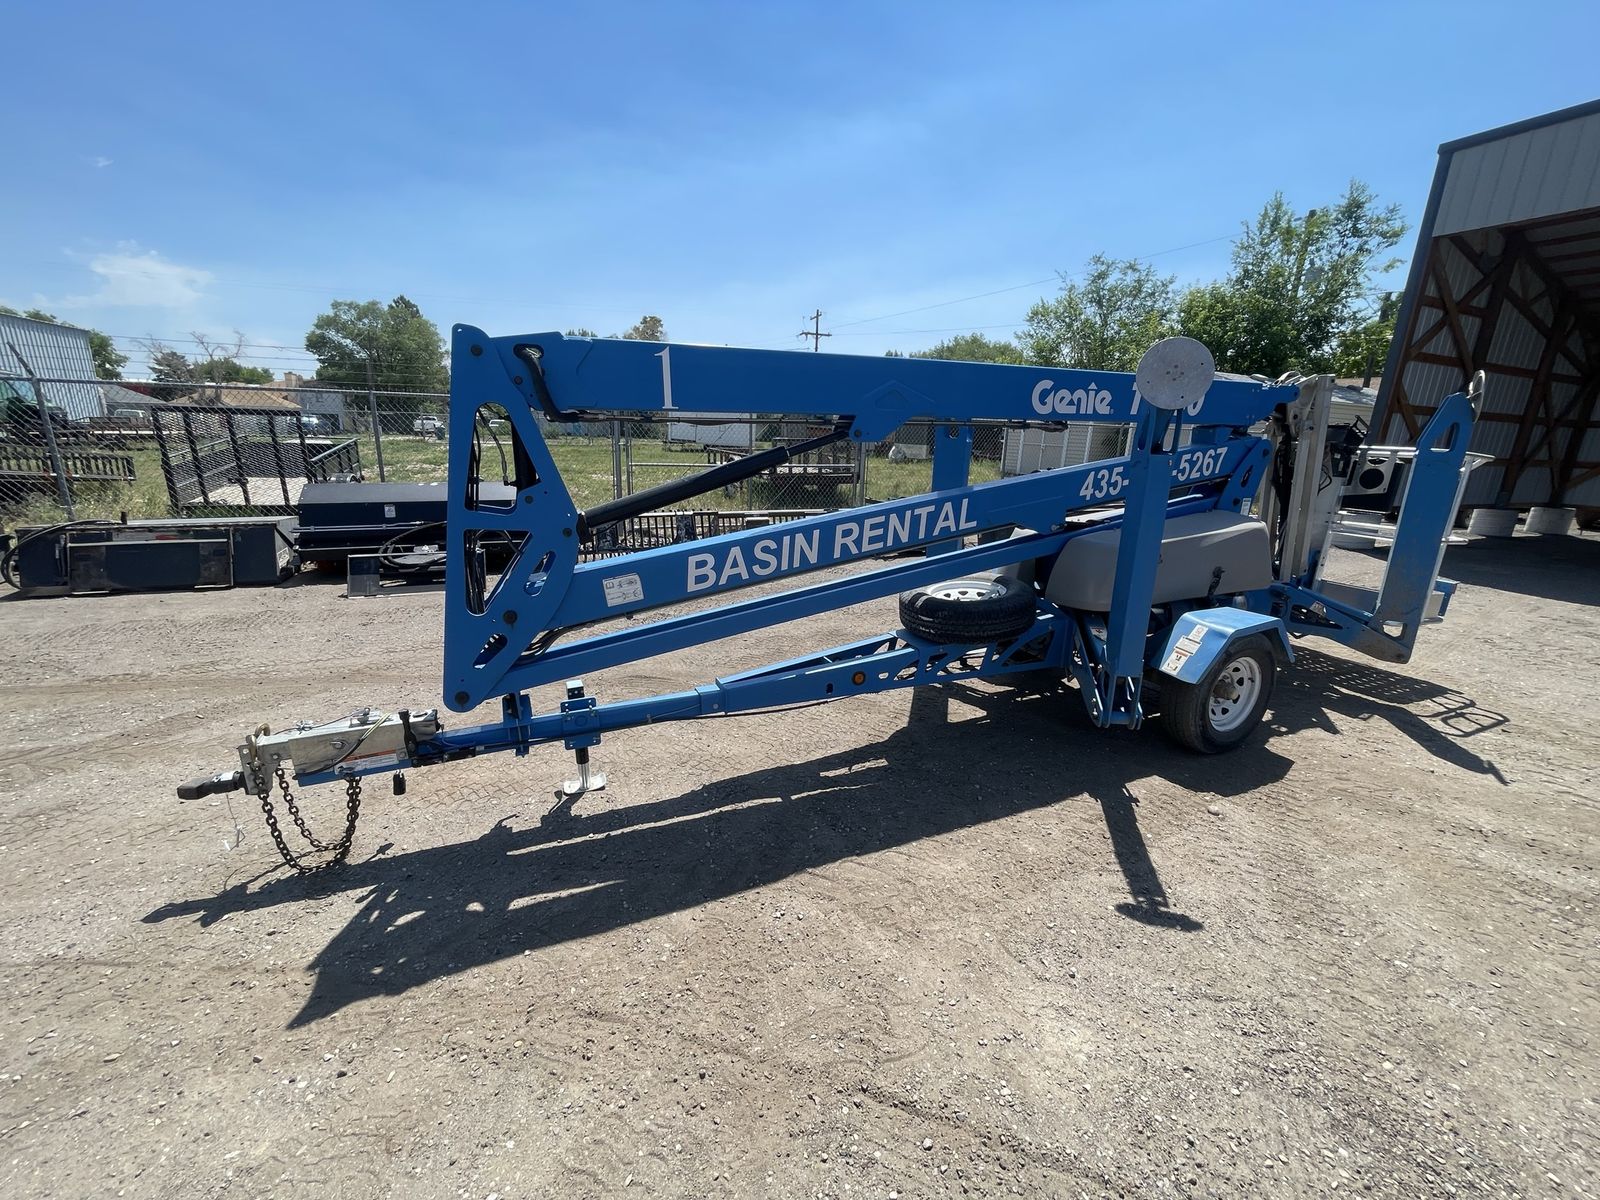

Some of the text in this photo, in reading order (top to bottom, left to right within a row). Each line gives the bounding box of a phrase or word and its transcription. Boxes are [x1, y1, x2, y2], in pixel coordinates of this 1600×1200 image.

[654, 346, 679, 409] 1
[1032, 379, 1113, 415] Genie
[1079, 446, 1228, 500] 435--5267
[687, 529, 820, 592] BASIN
[833, 498, 977, 558] RENTAL
